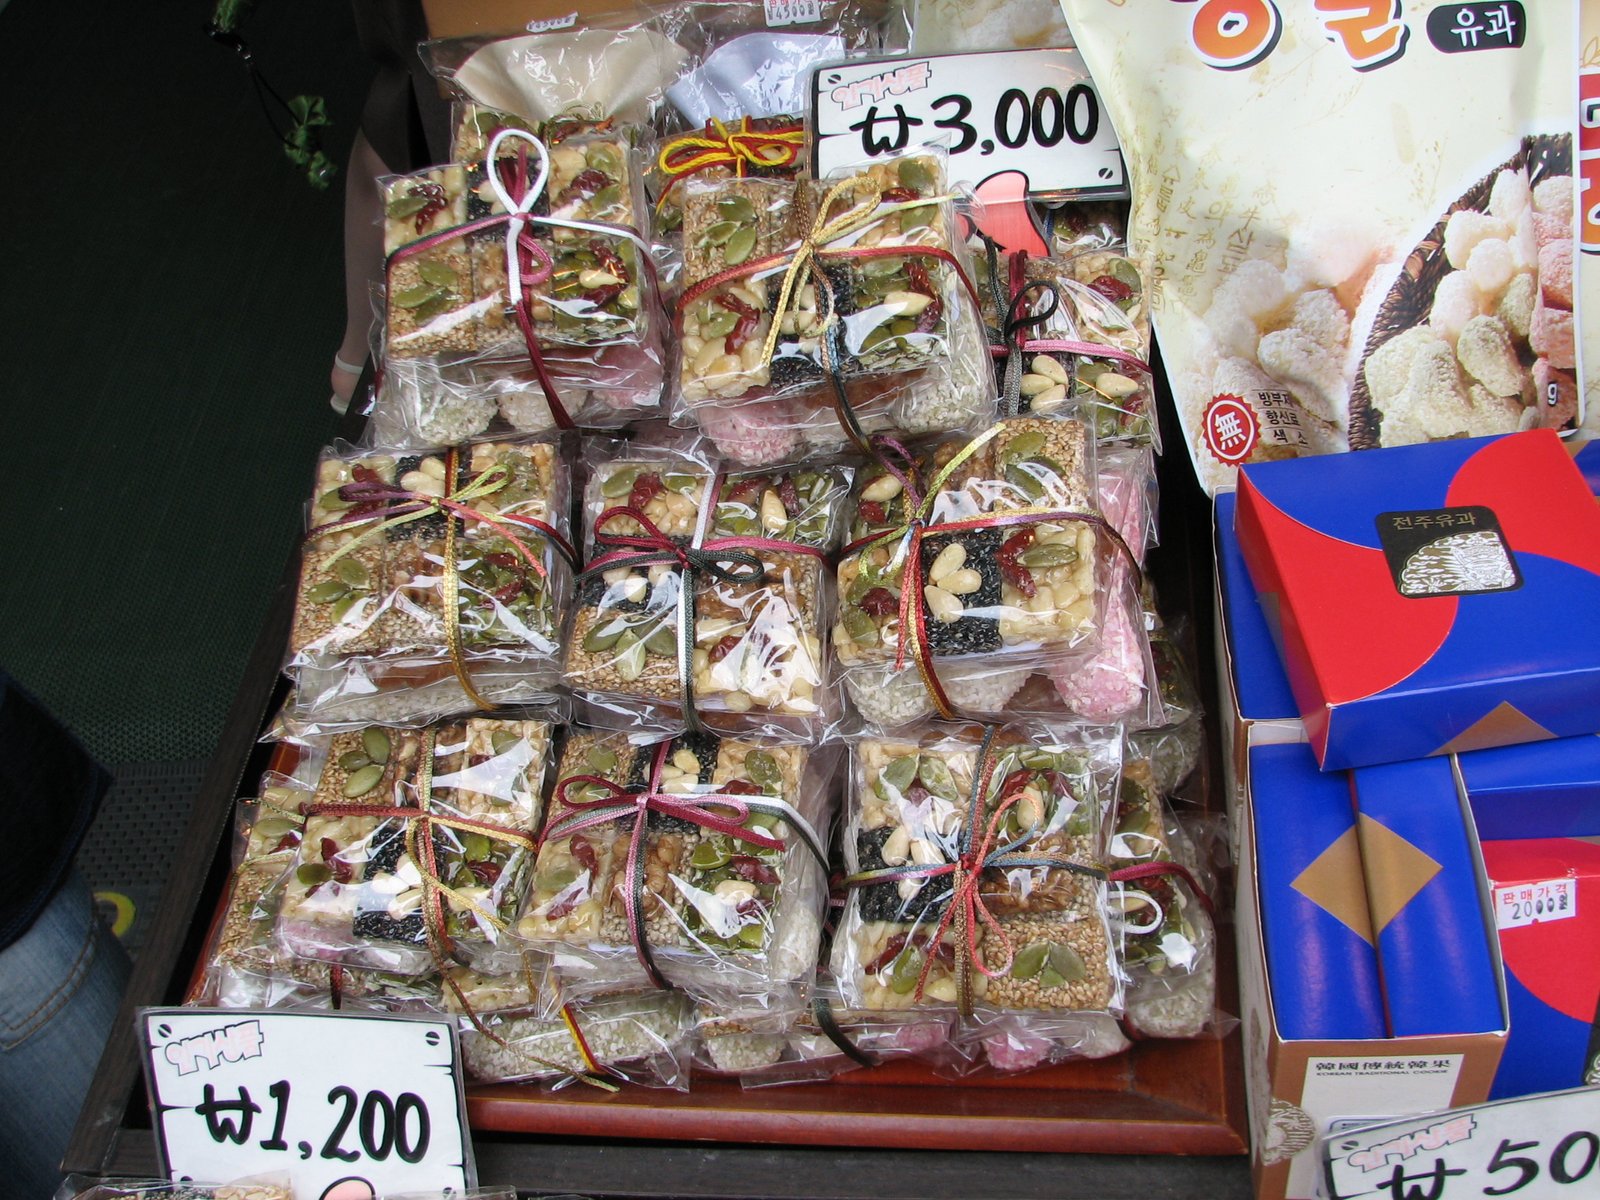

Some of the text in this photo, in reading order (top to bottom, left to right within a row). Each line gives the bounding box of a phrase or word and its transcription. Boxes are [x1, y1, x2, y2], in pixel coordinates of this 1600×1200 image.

[1450, 5, 1516, 47] 유과
[1214, 411, 1247, 451] 無
[1392, 512, 1477, 530] 전주유과
[195, 1079, 431, 1163] ₩1,200
